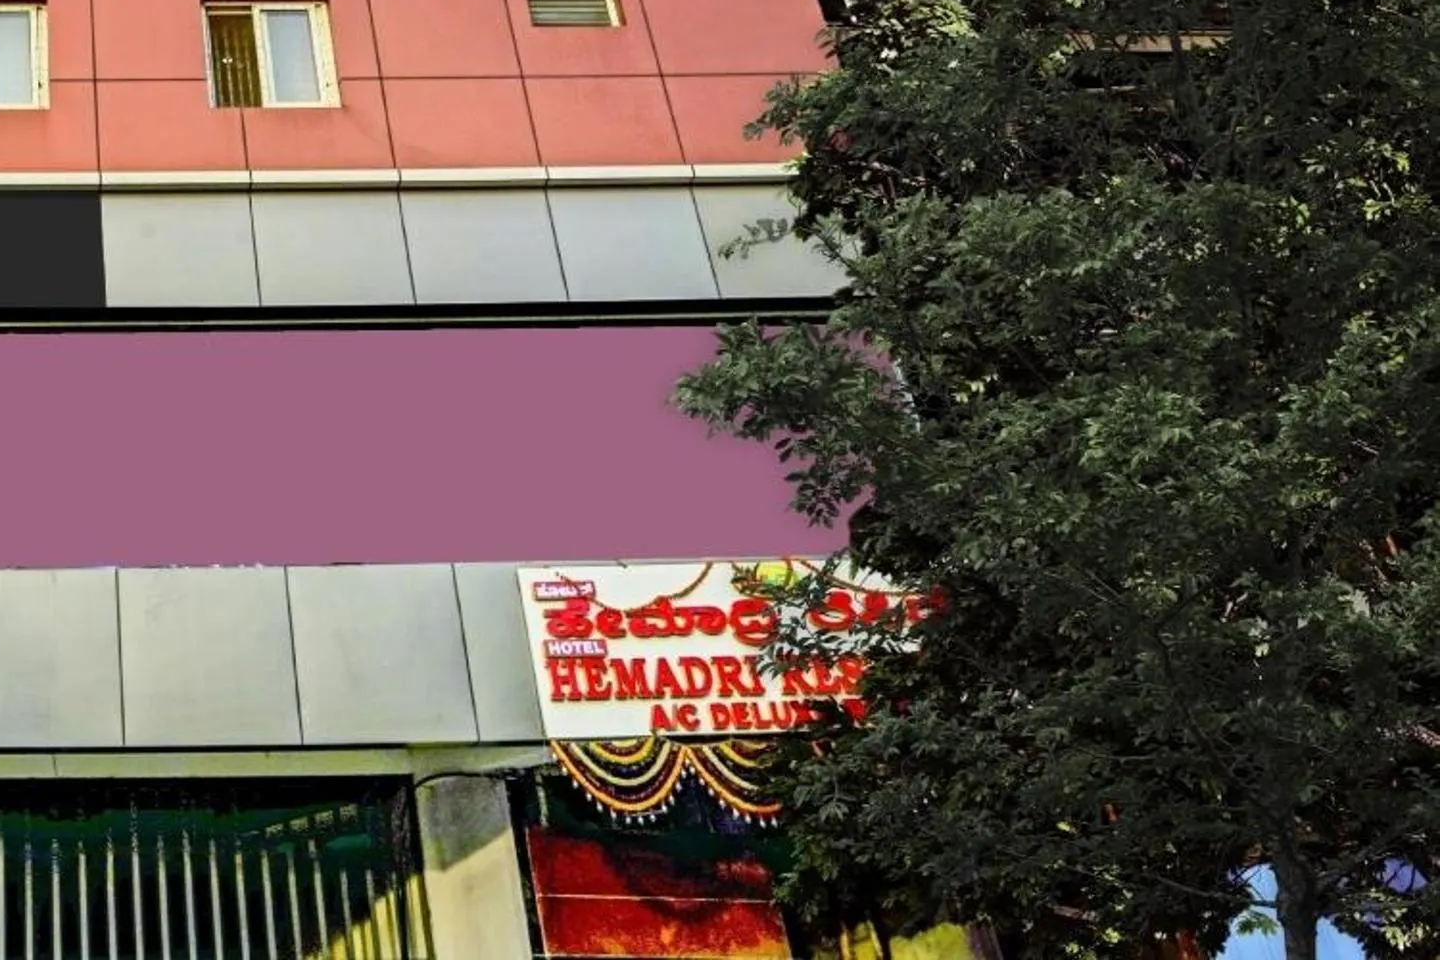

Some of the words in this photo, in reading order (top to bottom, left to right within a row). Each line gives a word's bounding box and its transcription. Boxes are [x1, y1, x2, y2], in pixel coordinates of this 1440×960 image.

[547, 641, 605, 656] HOTEL
[545, 655, 766, 701] HEMADRI
[709, 700, 836, 730] DELUX
